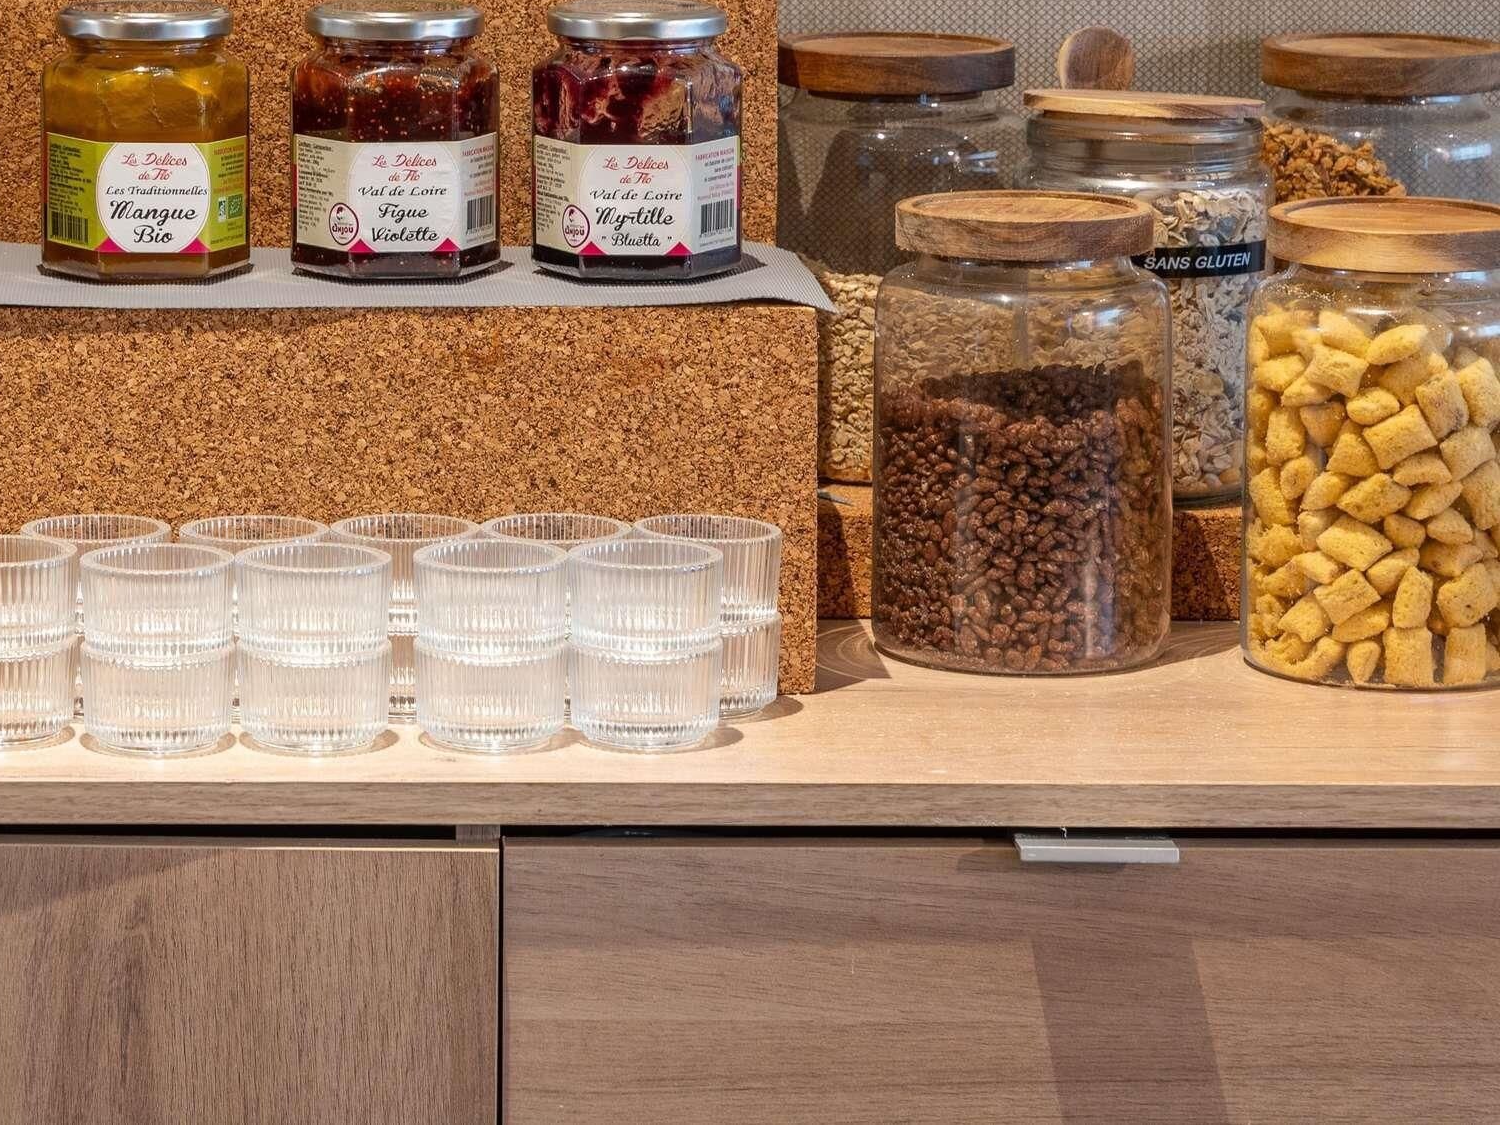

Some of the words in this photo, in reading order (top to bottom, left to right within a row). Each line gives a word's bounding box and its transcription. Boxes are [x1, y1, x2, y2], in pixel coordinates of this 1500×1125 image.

[120, 153, 138, 167] Les
[372, 154, 388, 168] Les
[602, 156, 619, 170] Les
[138, 170, 150, 180] de
[388, 172, 400, 182] de
[620, 174, 632, 184] de
[106, 186, 125, 195] Les
[128, 185, 208, 196] Traditionnelles
[358, 185, 385, 196] Val
[389, 185, 405, 196] de
[409, 186, 448, 196] Loire
[589, 189, 618, 200] Val
[622, 189, 639, 200] de
[643, 190, 683, 200] Loire
[110, 200, 199, 225] Mangue
[378, 202, 429, 224] Figue
[595, 206, 675, 231] Myrtille
[133, 225, 174, 244] Bio
[371, 226, 440, 243] Violette
[1143, 256, 1191, 270] SANS
[1194, 251, 1251, 269] GLUTEN
